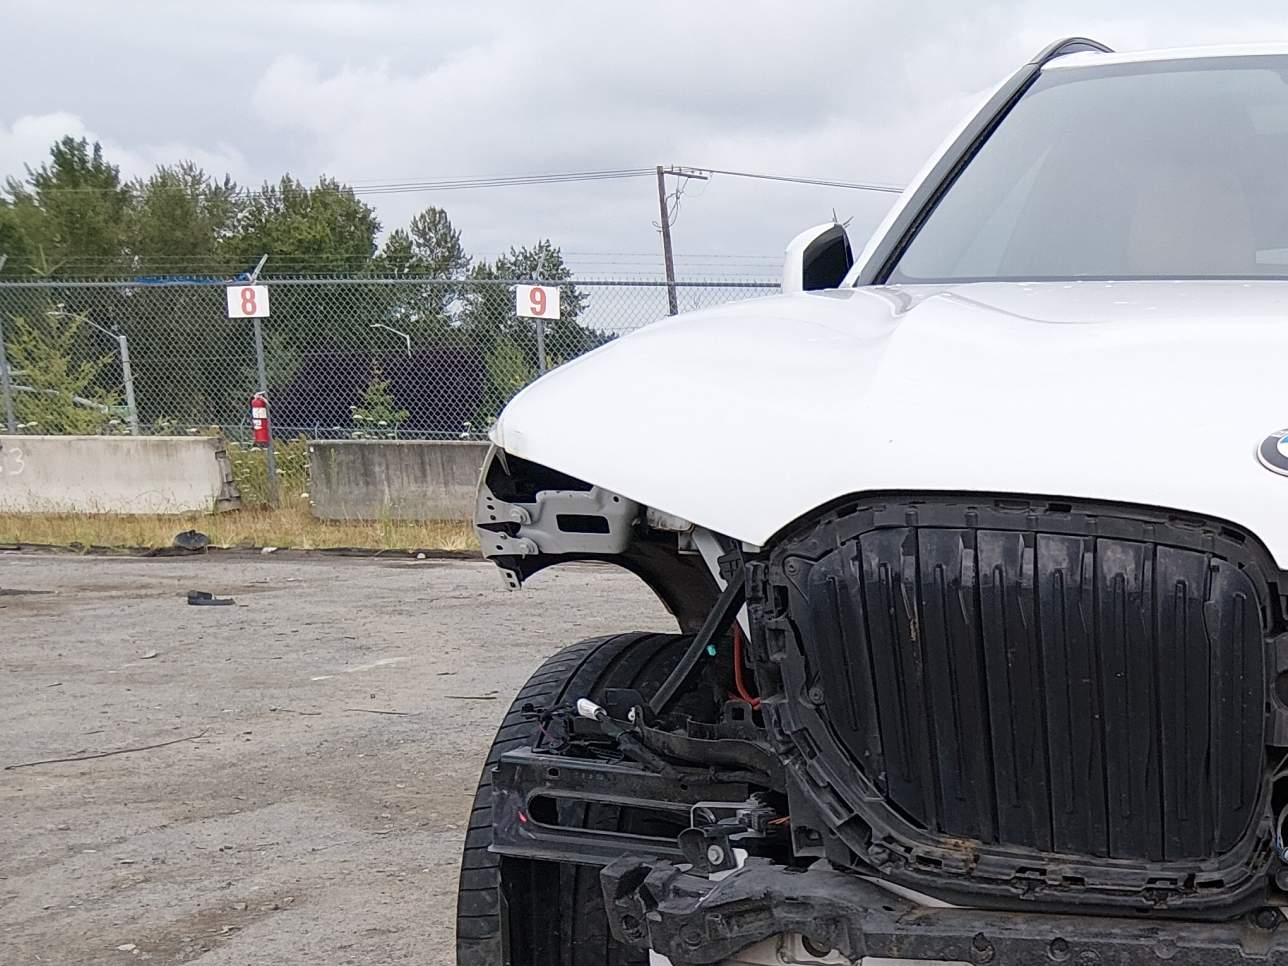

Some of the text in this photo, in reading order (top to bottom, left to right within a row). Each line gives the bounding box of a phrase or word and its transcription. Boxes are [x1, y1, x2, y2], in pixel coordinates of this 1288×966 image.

[241, 288, 257, 315] 8
[530, 288, 546, 315] 9
[0, 447, 24, 475] 3
